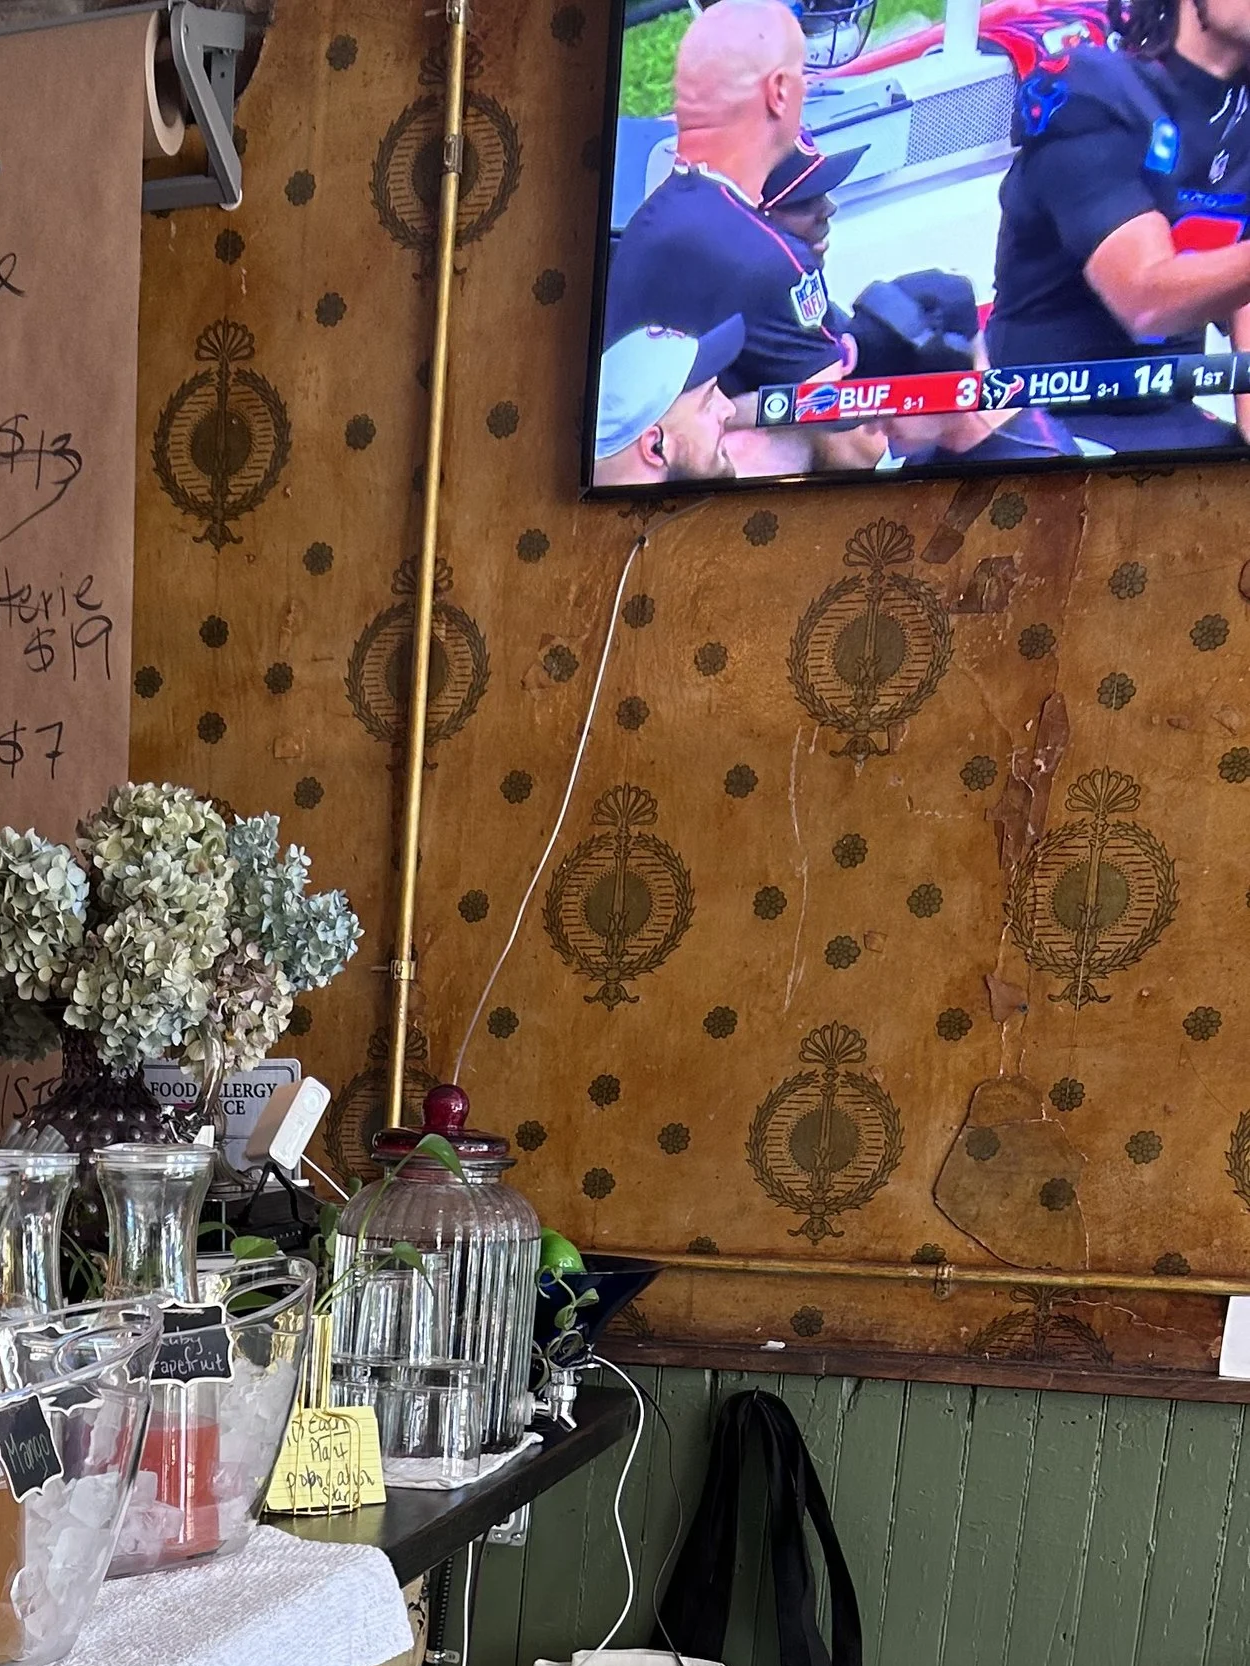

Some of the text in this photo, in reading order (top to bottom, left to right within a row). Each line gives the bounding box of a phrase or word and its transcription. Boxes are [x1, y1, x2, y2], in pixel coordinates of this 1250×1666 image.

[803, 292, 823, 317] NFL
[839, 384, 890, 410] BUF
[903, 396, 925, 410] 3-1
[956, 377, 978, 407] 3
[1029, 369, 1089, 397] HOU
[1097, 383, 1119, 397] 3-1
[1134, 363, 1173, 395] 14
[1193, 366, 1224, 387] 1ST
[23, 613, 114, 682] $19
[150, 1082, 278, 1099] FOOD LERGY
[153, 1346, 225, 1379] rapefruit
[4, 1433, 52, 1480] Mango
